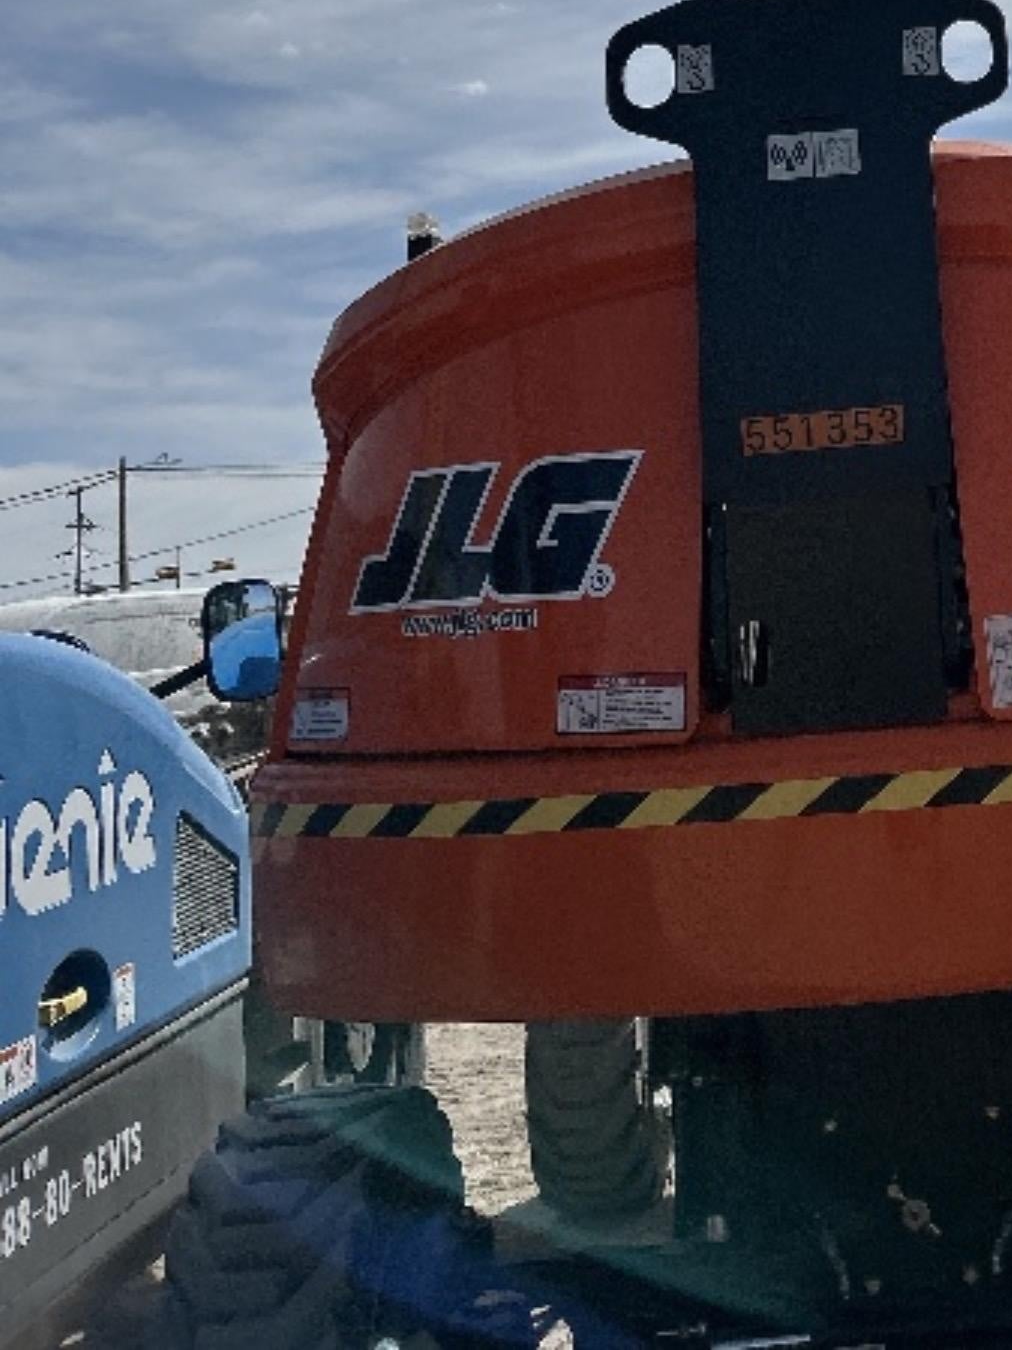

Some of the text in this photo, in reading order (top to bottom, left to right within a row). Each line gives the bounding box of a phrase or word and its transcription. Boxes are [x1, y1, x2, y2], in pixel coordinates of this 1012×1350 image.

[746, 407, 898, 451] 551353
[348, 449, 646, 615] JLG
[0, 748, 156, 922] enie
